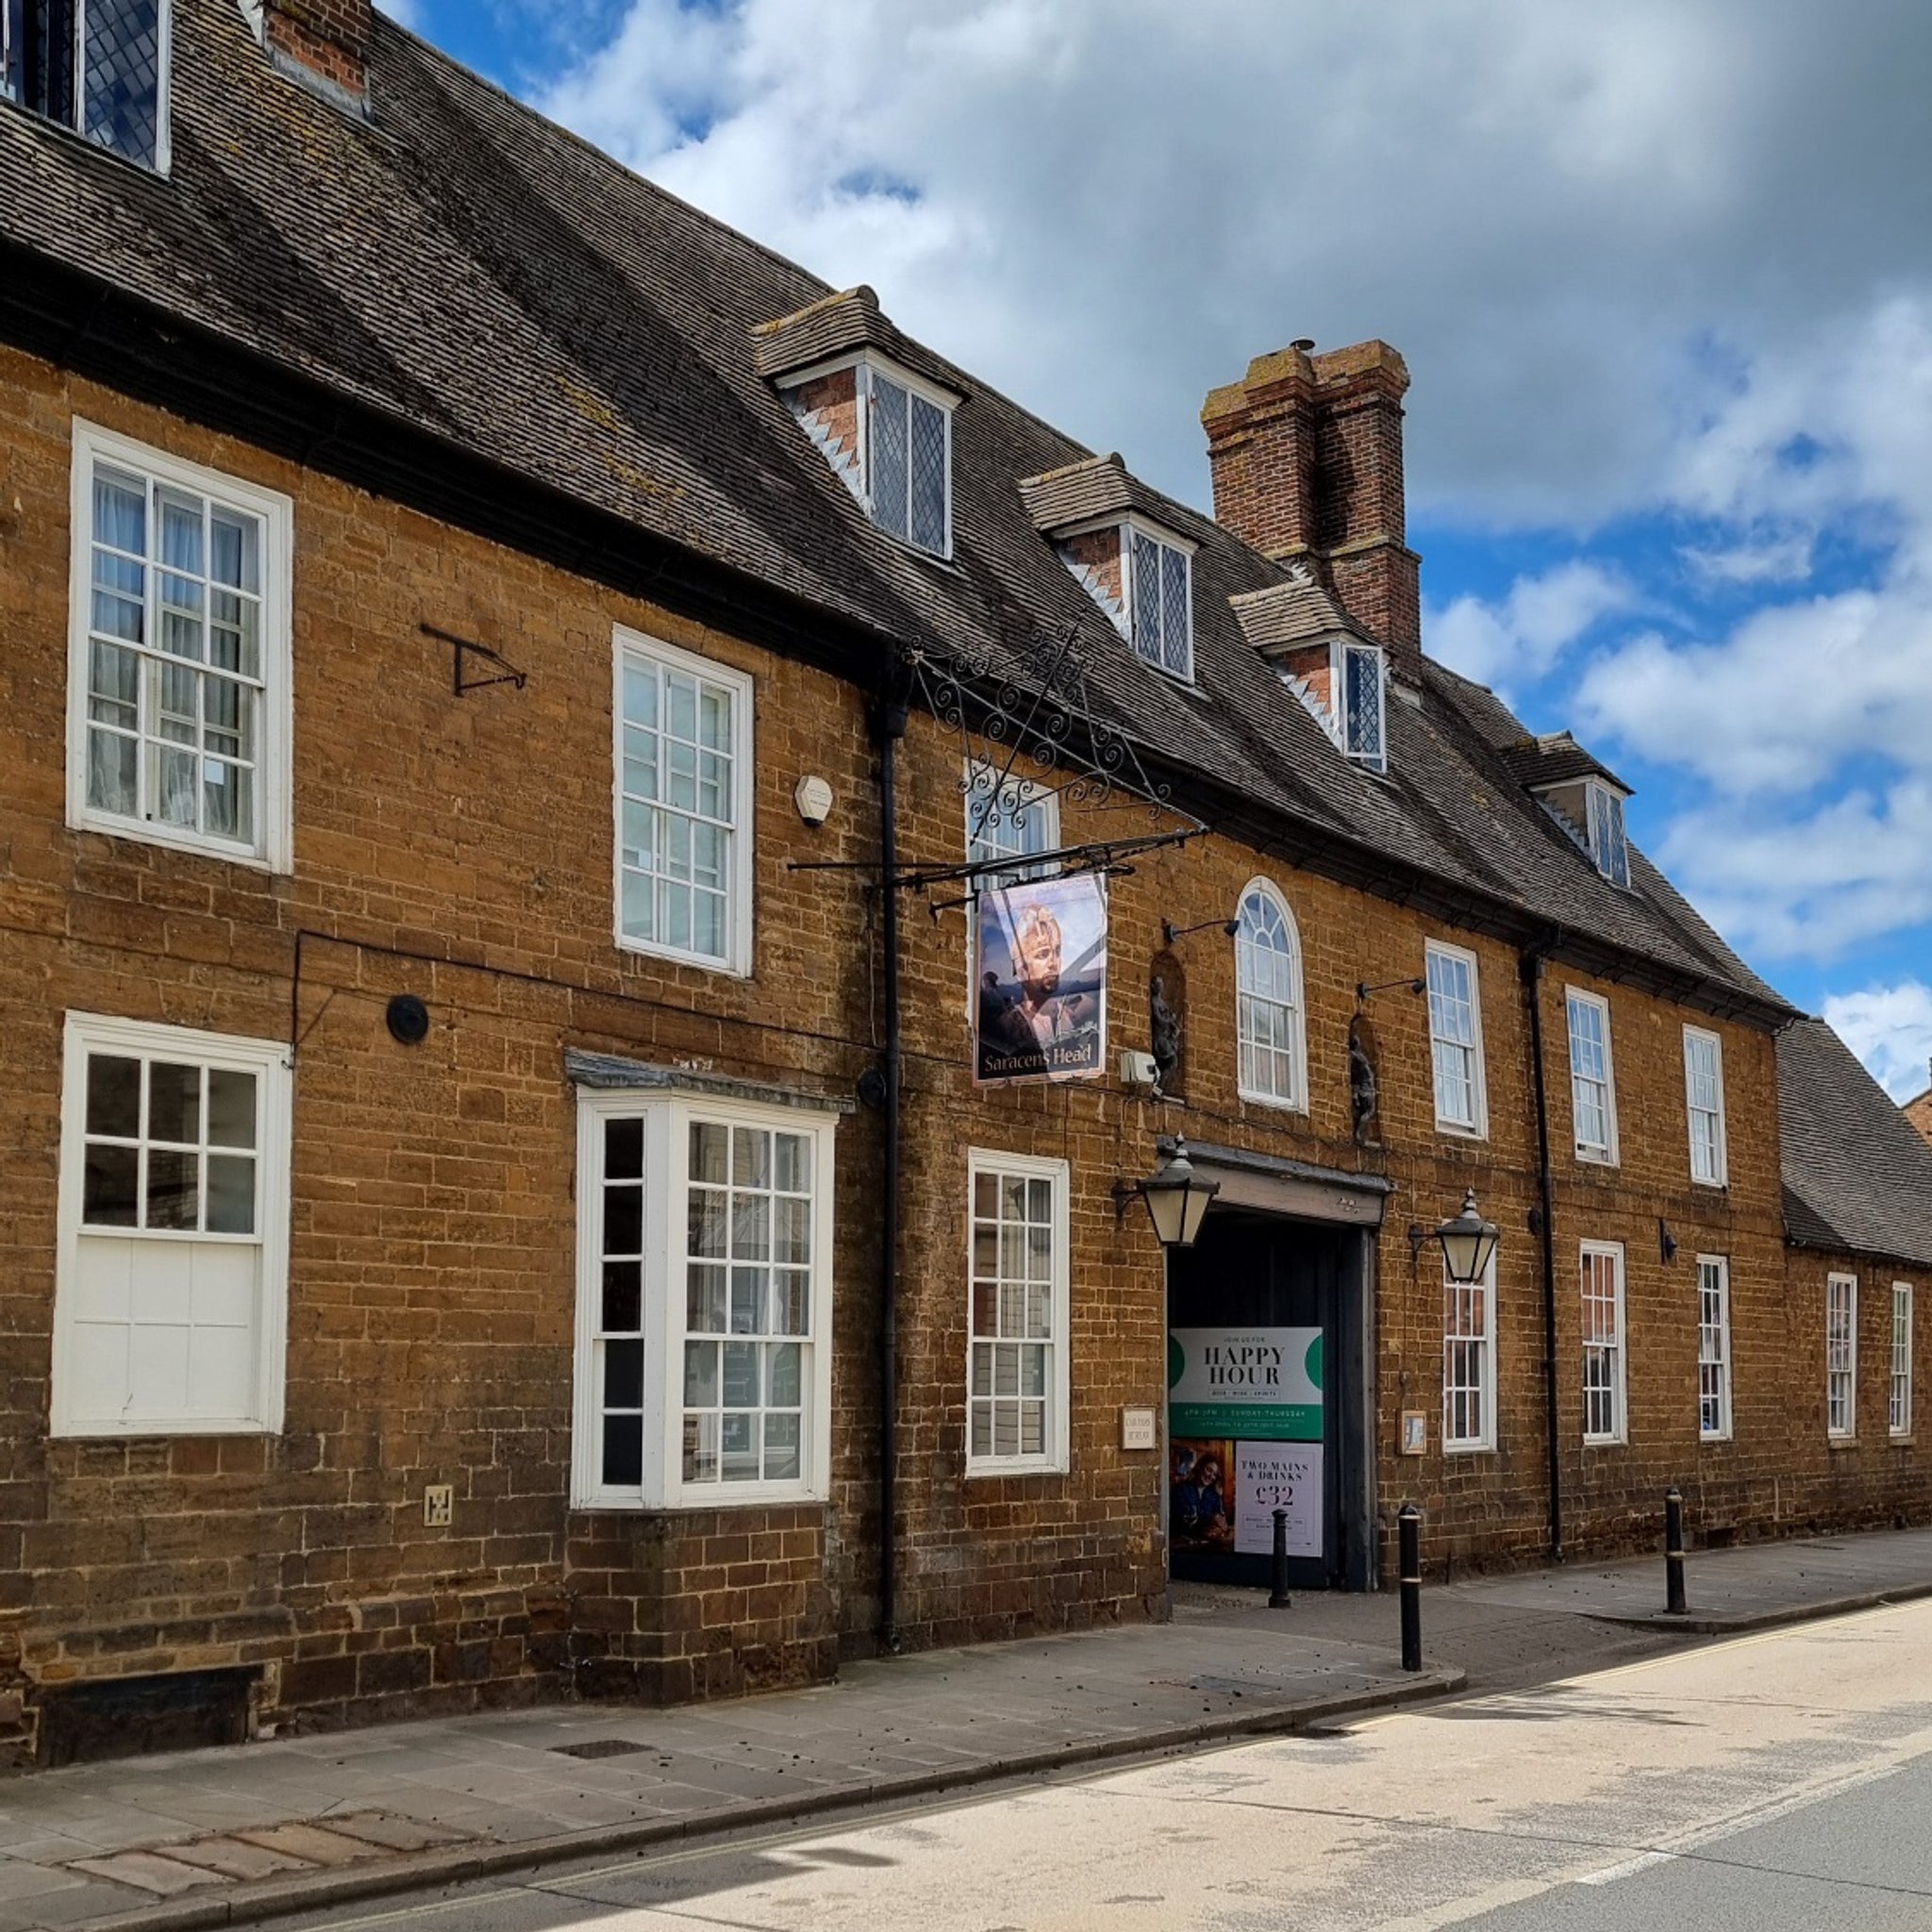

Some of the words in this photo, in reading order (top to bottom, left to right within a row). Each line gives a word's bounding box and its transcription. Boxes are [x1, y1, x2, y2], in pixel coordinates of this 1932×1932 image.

[984, 1052, 1050, 1073] Saracens
[1053, 1043, 1092, 1065] Head
[1204, 1346, 1286, 1365] HAPPY
[1209, 1367, 1280, 1385] HOUR
[1241, 1460, 1267, 1471] TWO
[1271, 1461, 1309, 1472] MAINS
[1258, 1471, 1303, 1482] DRINKS
[1255, 1485, 1294, 1507] £32
